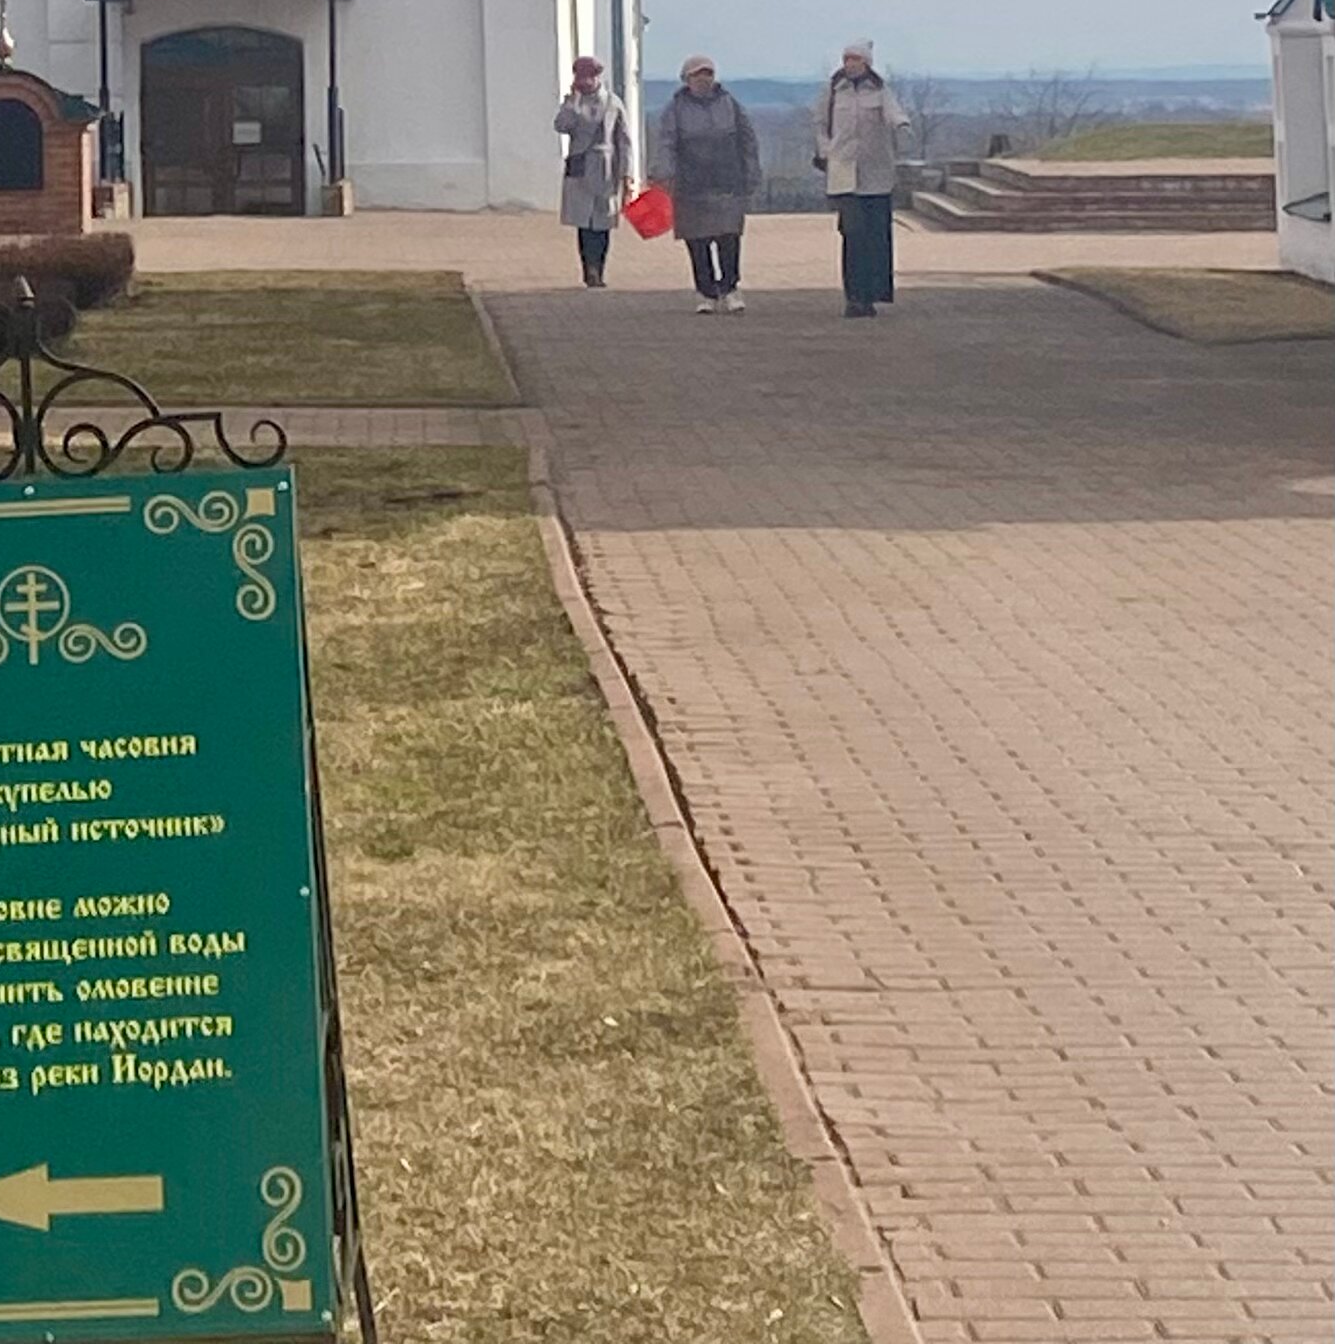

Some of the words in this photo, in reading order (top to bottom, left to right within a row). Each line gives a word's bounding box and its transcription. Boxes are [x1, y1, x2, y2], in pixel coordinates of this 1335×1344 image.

[80, 735, 196, 759] часовня
[71, 815, 225, 841] источник»
[73, 892, 170, 917] можно
[169, 932, 245, 958] воды
[76, 974, 219, 1002] омовение
[12, 1023, 62, 1051] где
[74, 1015, 232, 1050] находится
[31, 1064, 99, 1096] реки
[111, 1053, 232, 1090] Иордан.
